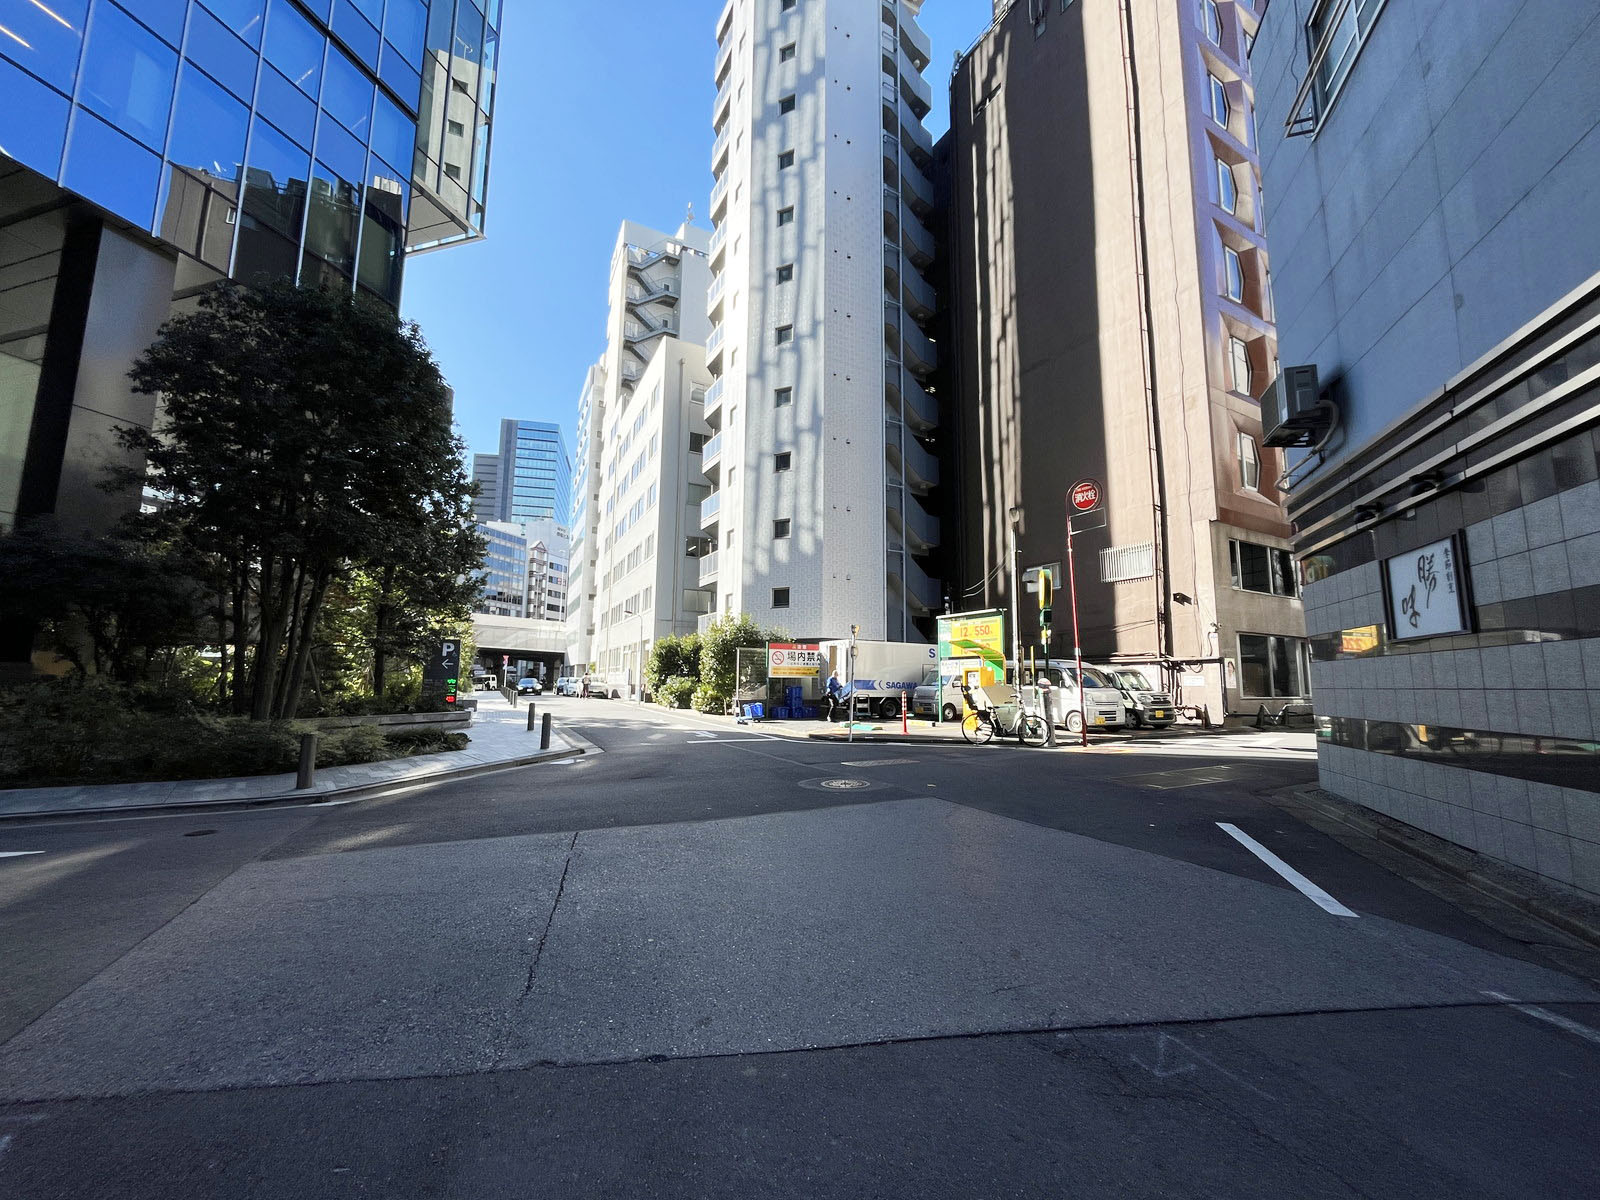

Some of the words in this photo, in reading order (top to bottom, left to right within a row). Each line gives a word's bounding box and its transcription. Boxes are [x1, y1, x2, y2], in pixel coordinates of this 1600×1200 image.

[1075, 489, 1096, 503] 消火栓
[442, 642, 455, 656] P
[885, 681, 918, 690] SAGAWA
